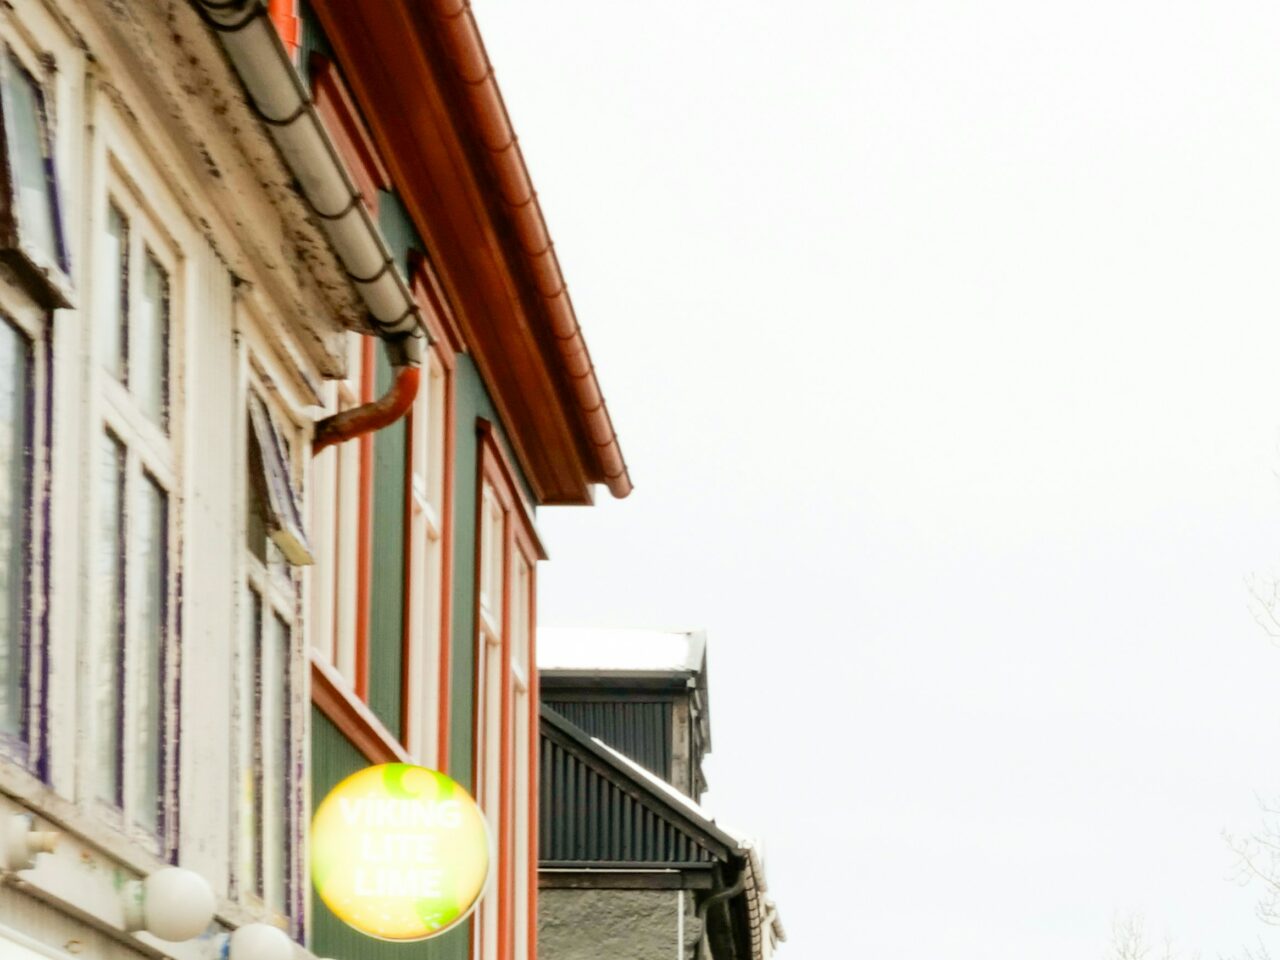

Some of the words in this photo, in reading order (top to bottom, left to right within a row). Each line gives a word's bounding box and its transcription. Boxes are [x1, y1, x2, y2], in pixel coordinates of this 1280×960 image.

[339, 797, 463, 829] VIKING
[361, 831, 436, 864] LITE
[354, 867, 443, 898] LIME
